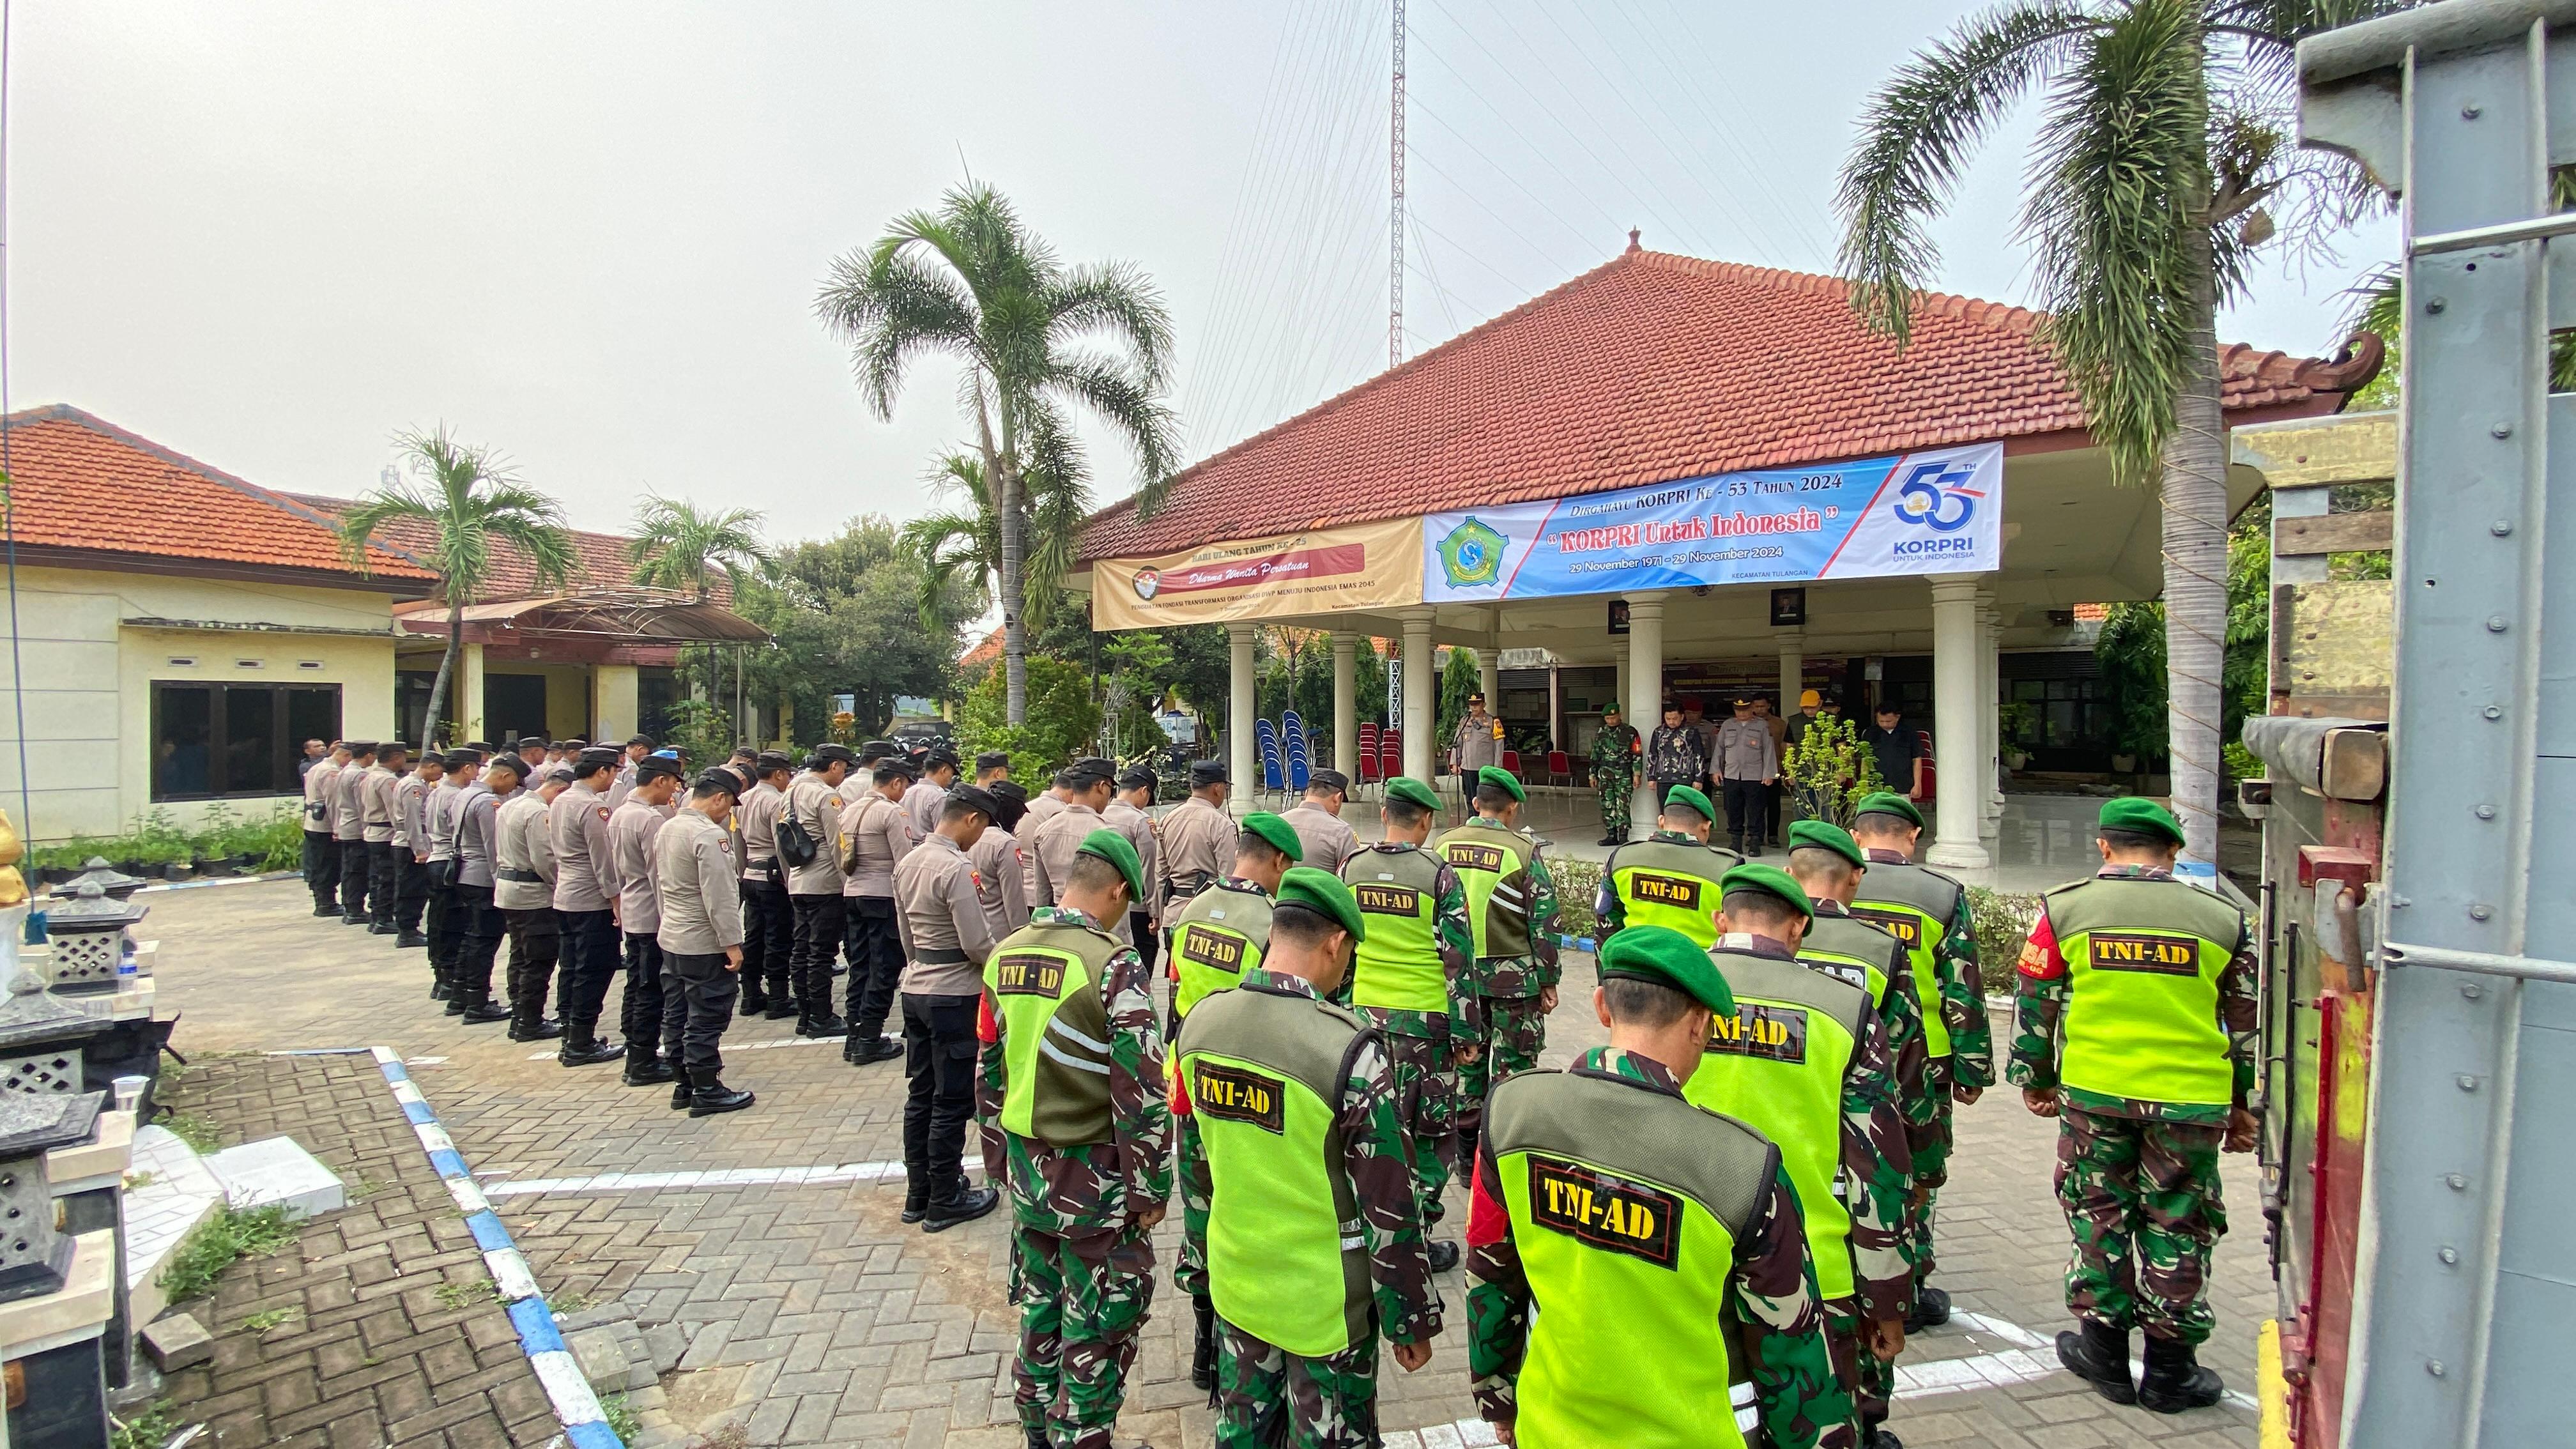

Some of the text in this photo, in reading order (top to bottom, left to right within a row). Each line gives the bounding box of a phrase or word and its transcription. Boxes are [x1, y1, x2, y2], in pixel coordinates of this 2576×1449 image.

[1570, 500, 1631, 517] DIRGAHAYU
[1636, 489, 1691, 509] KORPRI
[1728, 482, 1747, 496] 53
[1800, 473, 1842, 491] 2024
[1894, 460, 1975, 533] 53
[1560, 523, 1641, 554] KORPRI
[1644, 514, 1708, 544] Untuk
[1710, 505, 1821, 539] Indonesia
[1192, 553, 1211, 562] HARI
[1213, 549, 1242, 559] ULANG
[1243, 543, 1275, 555] TAHUN
[1569, 564, 1583, 574] 29
[1584, 558, 1639, 573] November
[1642, 556, 1662, 568] 1971
[1673, 553, 1687, 565] 29
[1689, 544, 1749, 563] November
[1751, 546, 1783, 558] 2024
[1894, 537, 1973, 555] KORPRI
[1925, 551, 1975, 560] INDONESIA
[1189, 572, 1222, 585] Dharma
[1261, 562, 1309, 576] Persatuan
[1184, 597, 1226, 606] TRANSFORMASI
[1277, 587, 1303, 596] MENUJU
[1304, 584, 1338, 593] INDONESIA
[1339, 582, 1357, 590] EMAS
[1361, 891, 1413, 909] TNI-AD
[1640, 880, 1690, 900] TNI-AD
[1189, 934, 1236, 963] TNI-AD
[2096, 940, 2190, 964] TNI-AD
[1712, 1014, 1788, 1046] NI-AD
[1201, 1075, 1269, 1114] TNI-AD
[1544, 1177, 1655, 1240] TNI-AD
